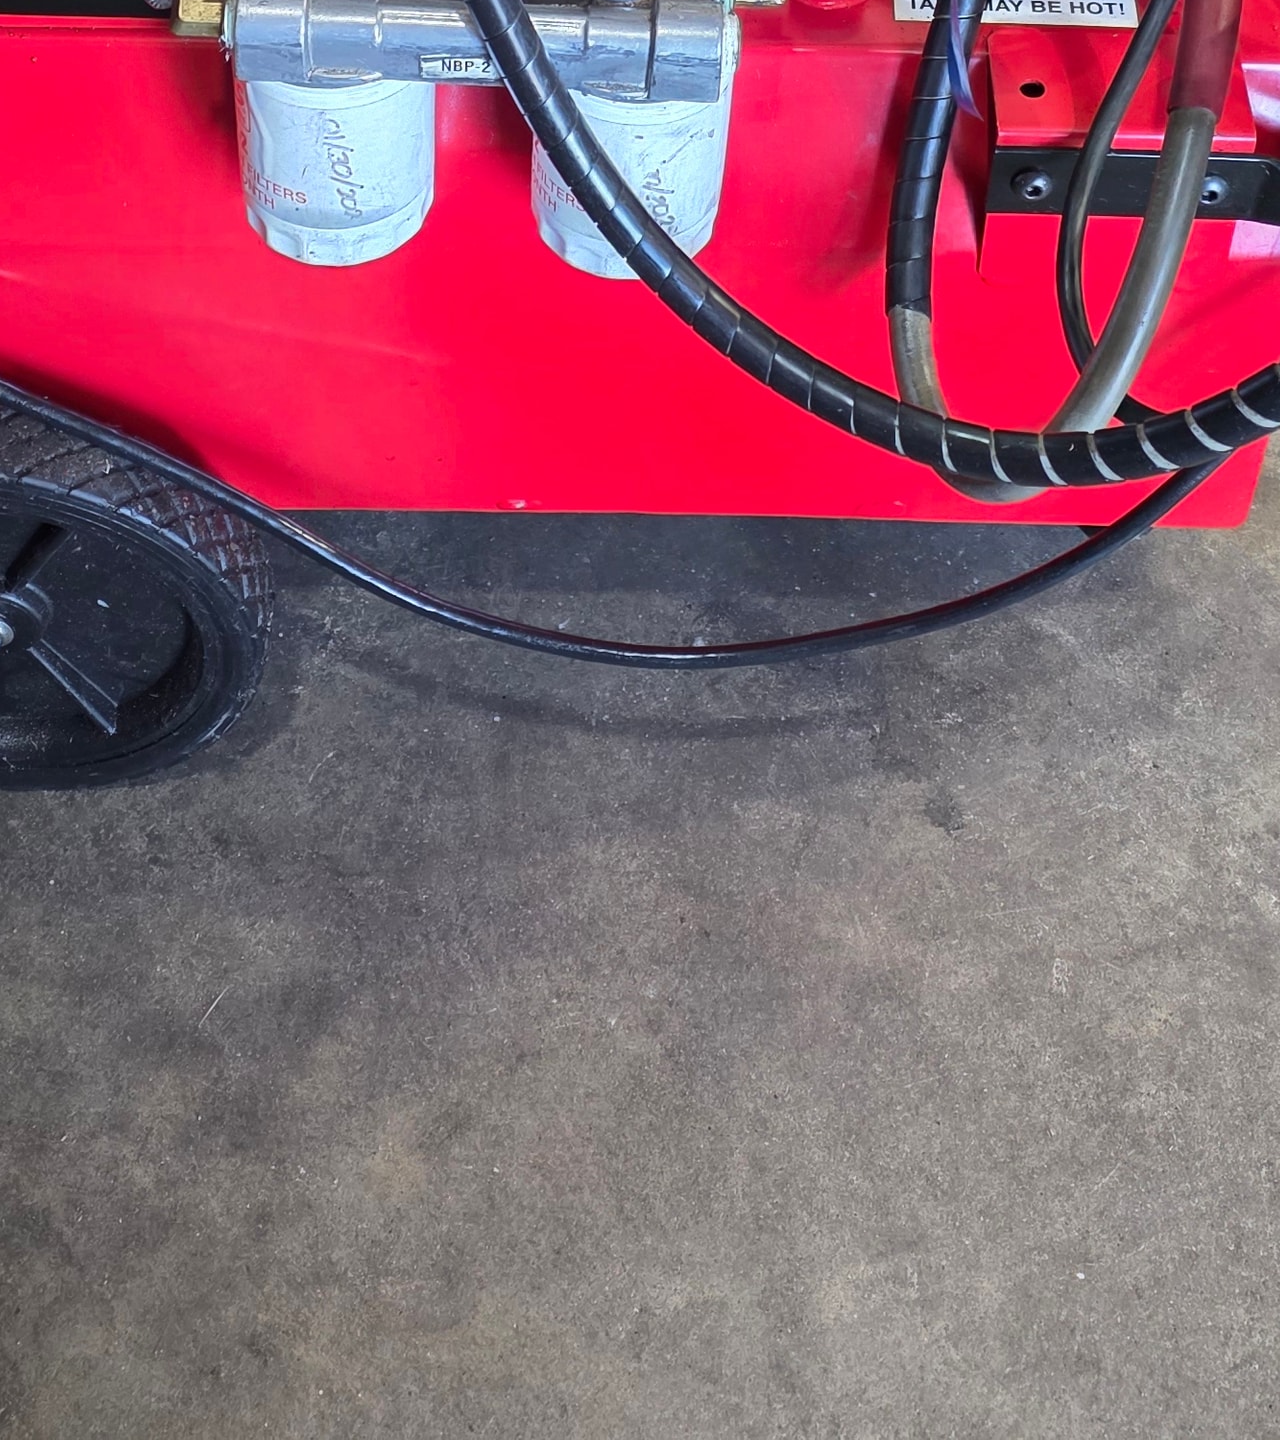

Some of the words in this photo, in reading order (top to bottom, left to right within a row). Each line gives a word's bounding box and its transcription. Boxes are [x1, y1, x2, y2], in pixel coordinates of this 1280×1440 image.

[1031, 0, 1062, 14] BE
[1070, 1, 1126, 16] HOT!
[441, 59, 492, 74] NBP-2
[247, 164, 308, 206] FILTERS
